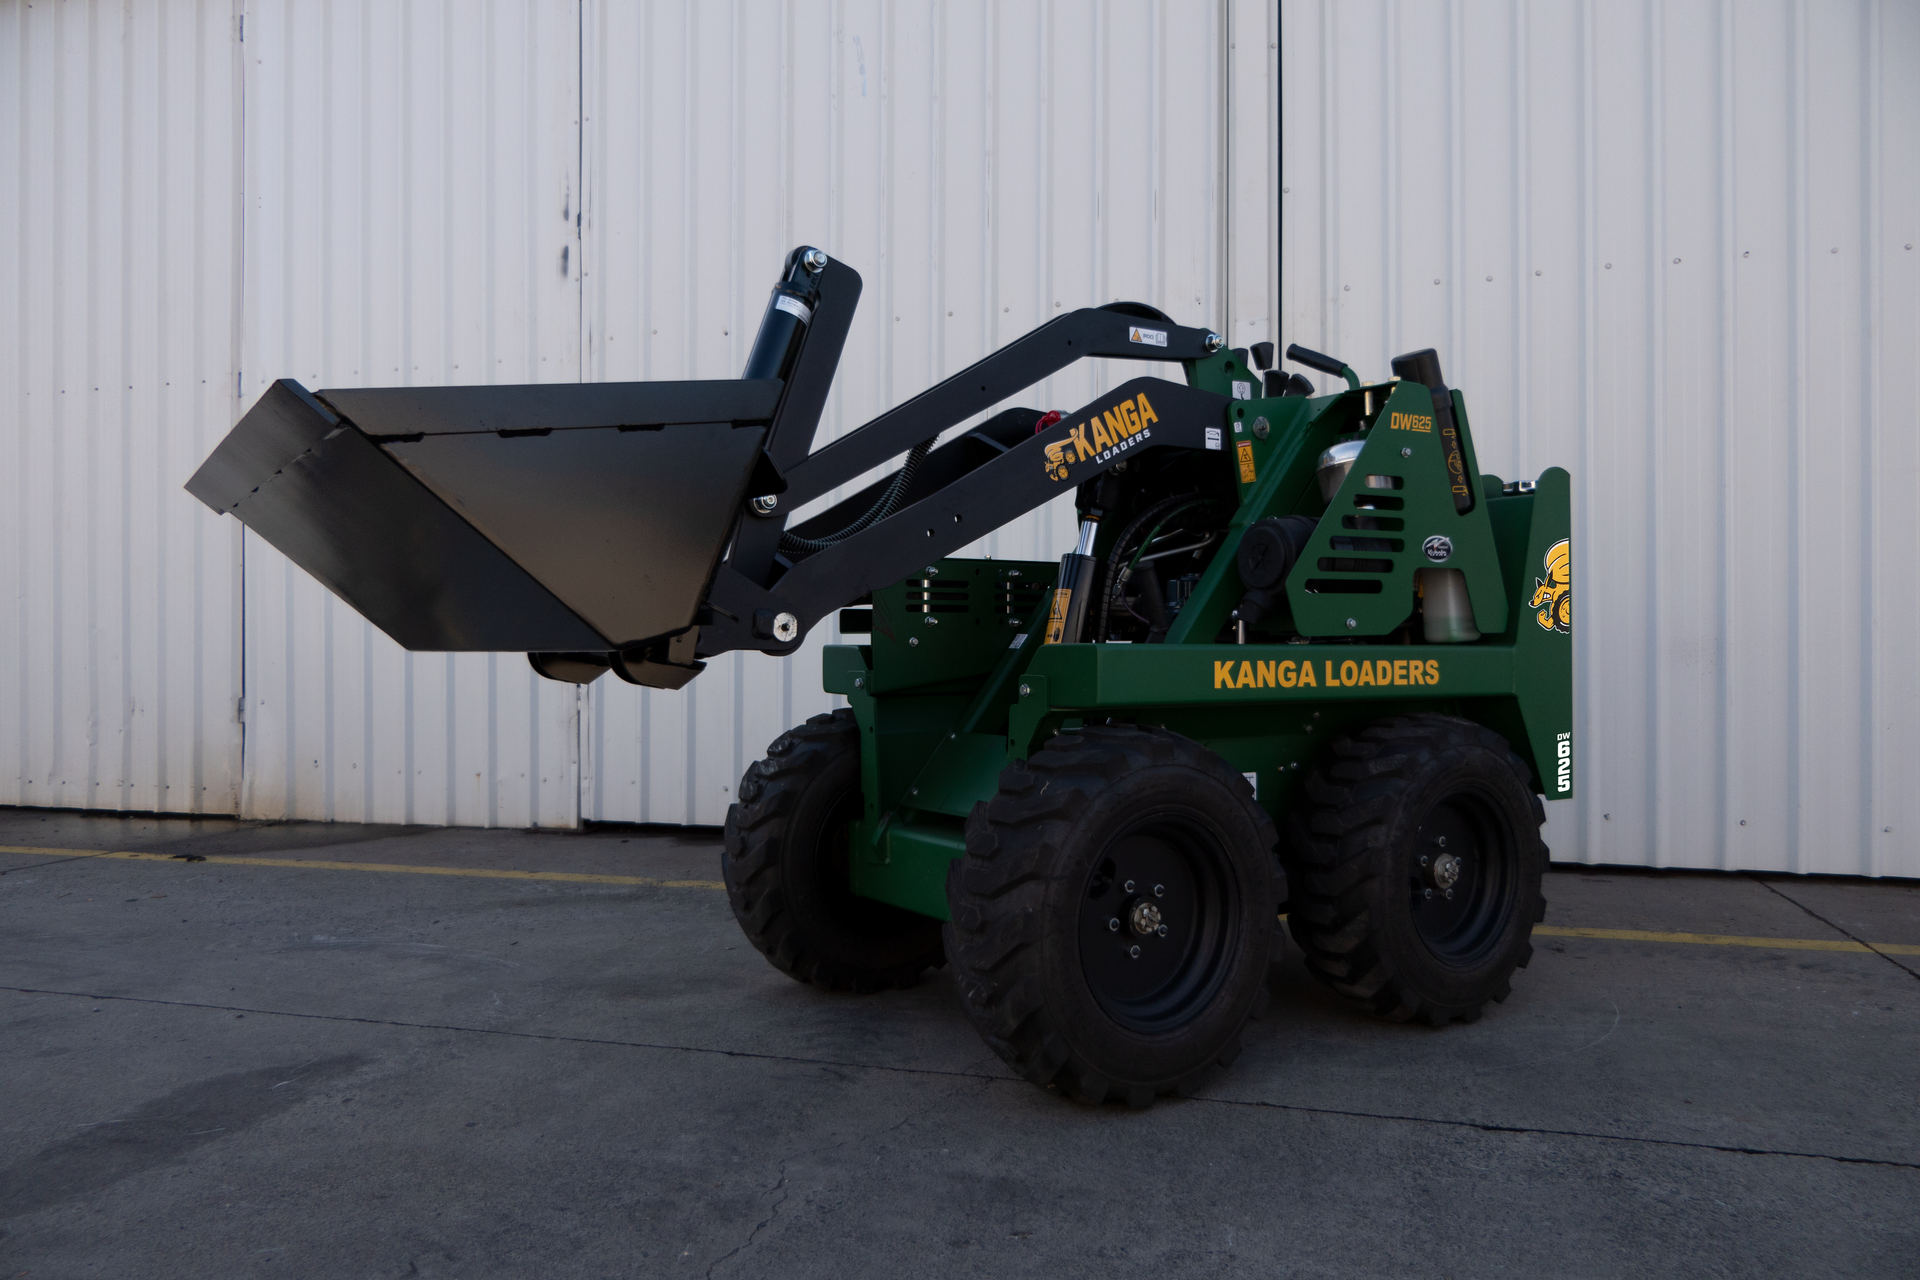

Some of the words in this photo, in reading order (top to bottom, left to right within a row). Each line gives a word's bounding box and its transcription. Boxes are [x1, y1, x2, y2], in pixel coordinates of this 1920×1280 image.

[1074, 392, 1159, 462] KANGA
[1390, 412, 1432, 431] DW625
[1096, 429, 1151, 464] LOADERS
[1214, 660, 1317, 689] KANGA
[1325, 659, 1440, 686] LOADERS
[1557, 732, 1571, 741] DW
[1557, 740, 1571, 793] 625
